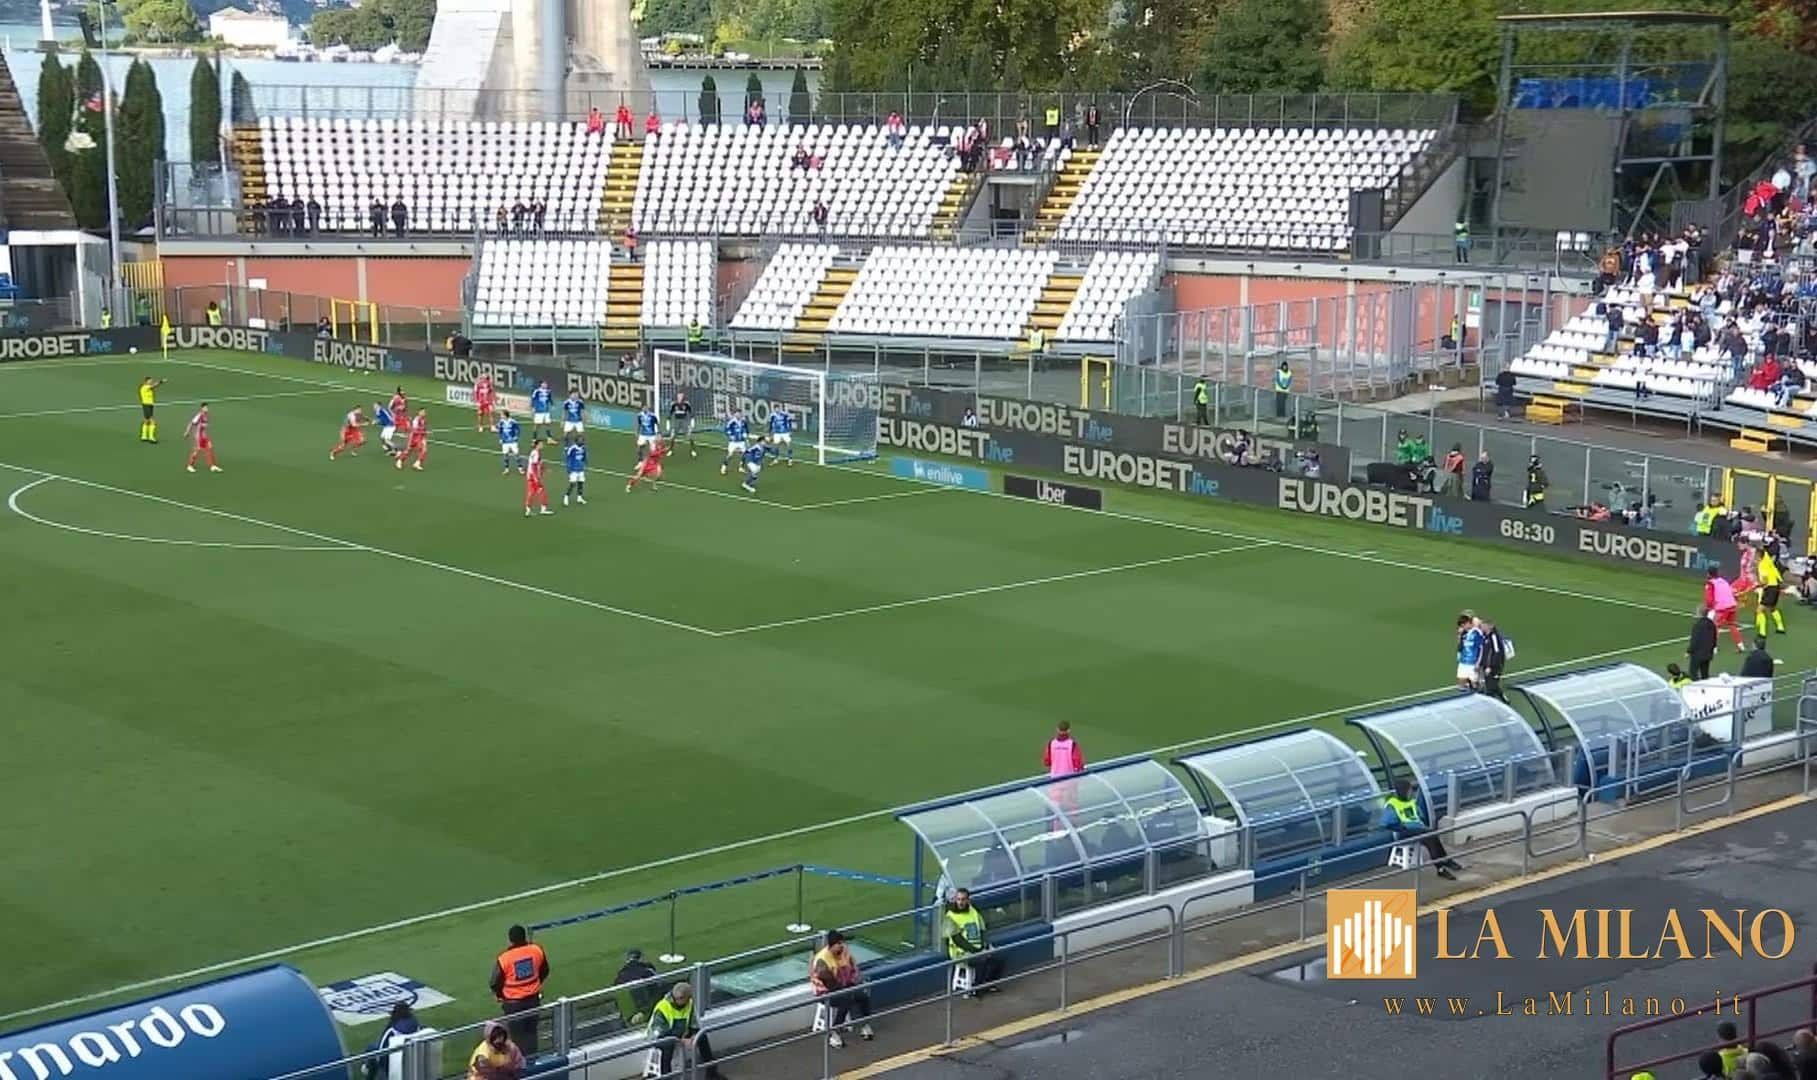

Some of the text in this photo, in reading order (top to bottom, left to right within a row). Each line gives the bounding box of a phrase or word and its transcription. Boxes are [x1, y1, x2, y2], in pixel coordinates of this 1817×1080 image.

[927, 469, 963, 485] enilive
[1036, 480, 1066, 504] Uber
[1500, 519, 1555, 545] 68:30
